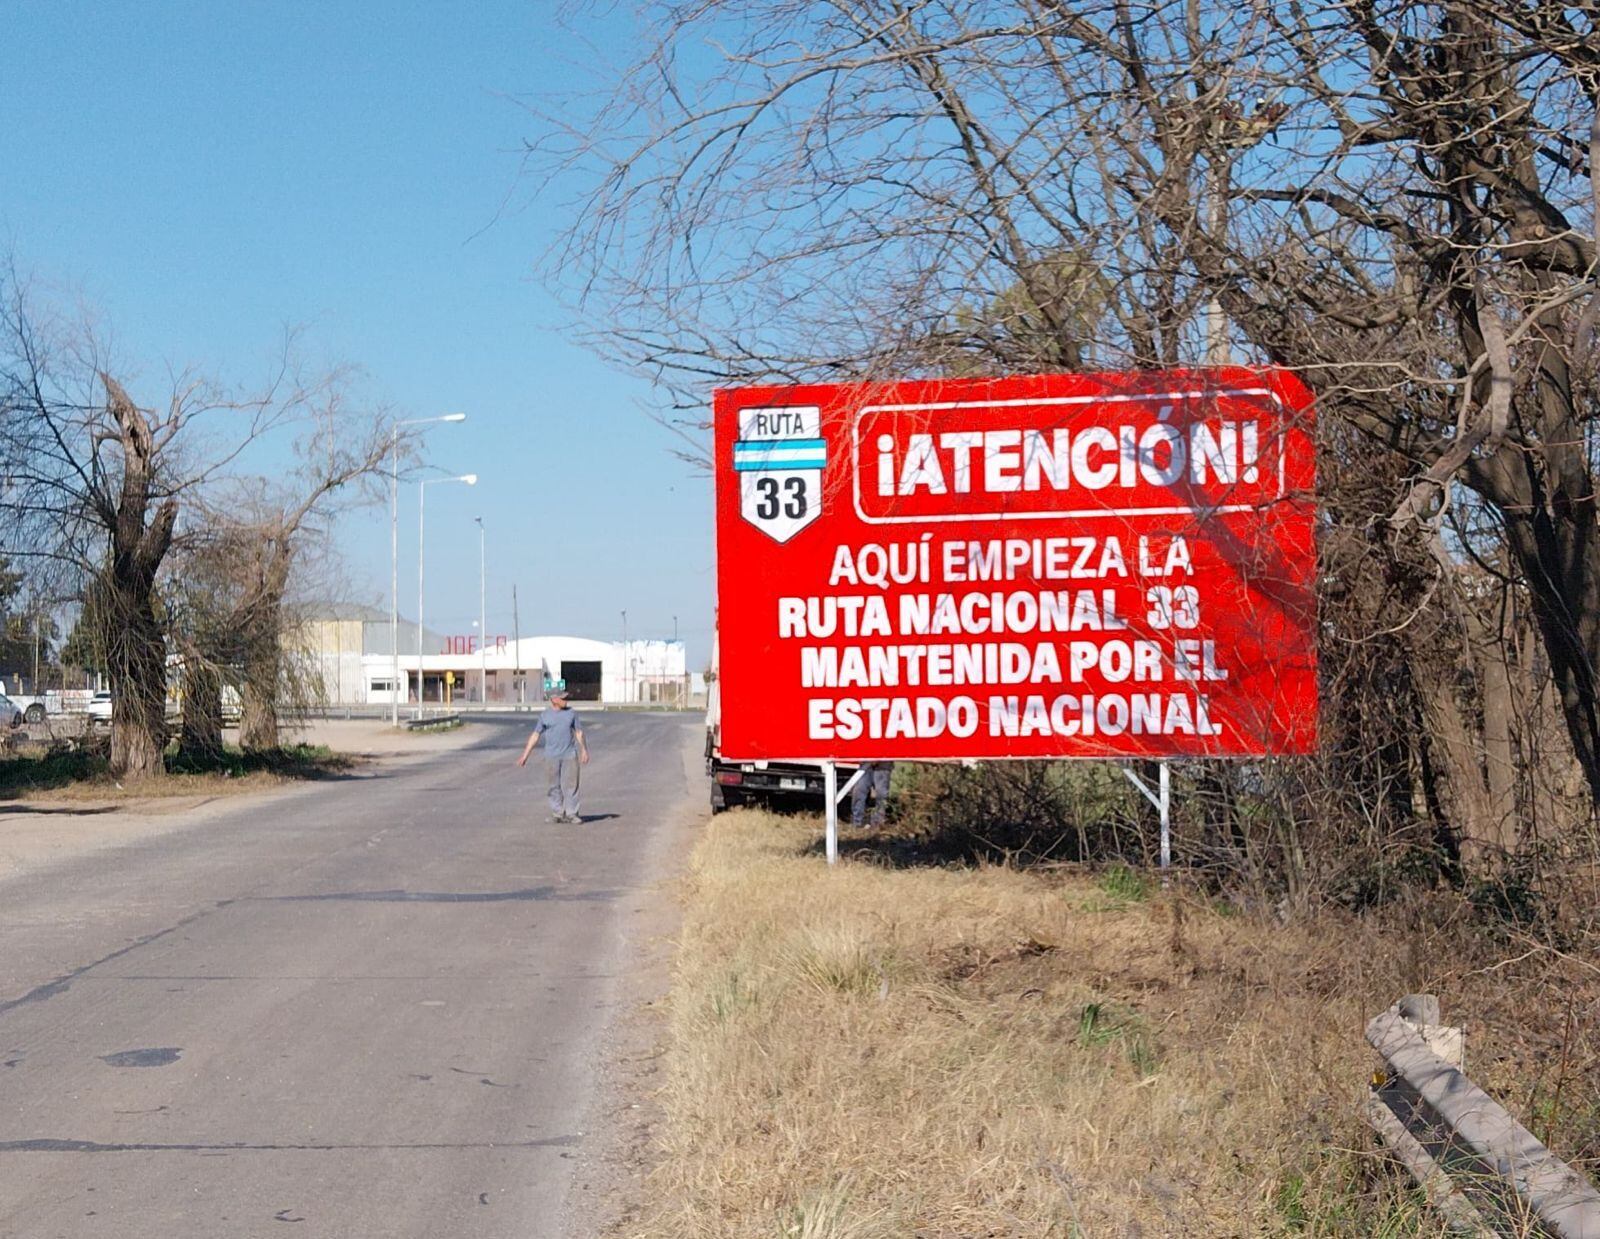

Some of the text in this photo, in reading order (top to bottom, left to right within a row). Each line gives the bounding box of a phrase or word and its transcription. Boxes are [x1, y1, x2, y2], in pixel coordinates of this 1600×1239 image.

[757, 413, 804, 436] RUTA
[877, 406, 1260, 497] ¡ATENCIÓN!
[756, 477, 807, 520] 33
[828, 533, 1194, 590] AQUÍ EMPIEZA LA
[778, 585, 1200, 639] RUTA NACIONAL 33
[800, 639, 1229, 688] MANTENIDA POR EL
[808, 693, 1223, 740] ESTADO NACIONAL
